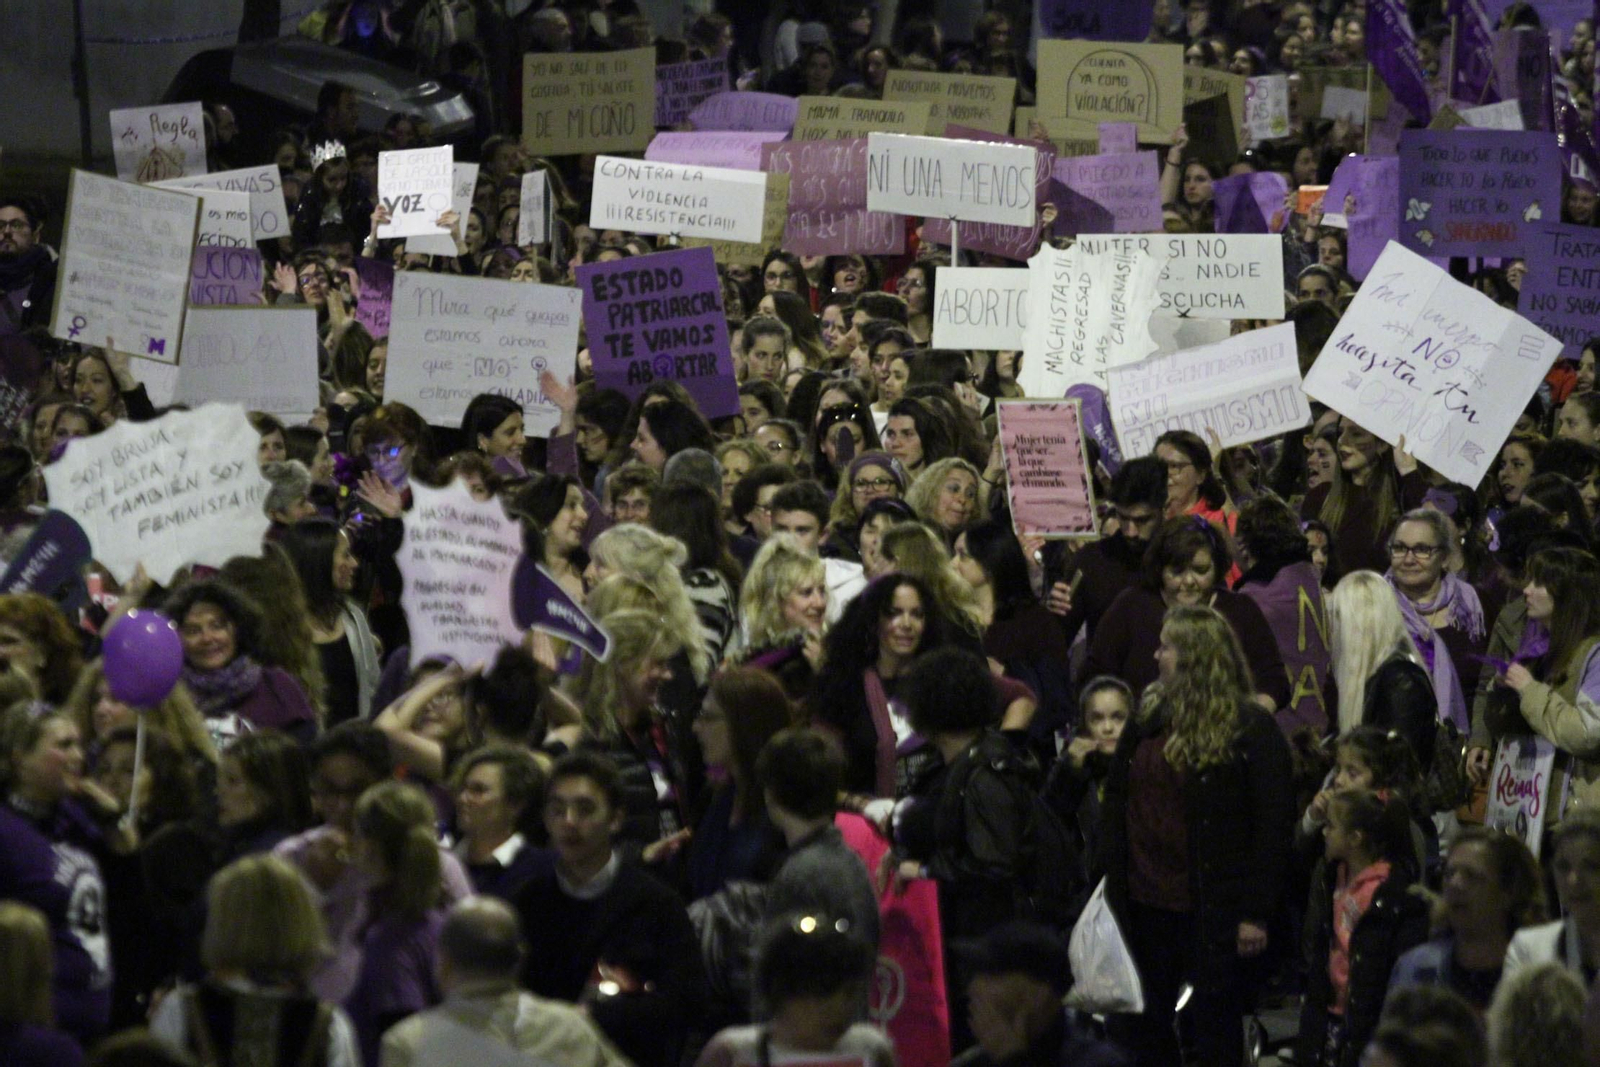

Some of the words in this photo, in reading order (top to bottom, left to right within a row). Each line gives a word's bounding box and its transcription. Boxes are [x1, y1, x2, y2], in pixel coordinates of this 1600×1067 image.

[1077, 72, 1093, 86] YA
[1097, 73, 1129, 88] COMO
[536, 111, 552, 139] DE
[589, 100, 636, 139] COÑO
[599, 160, 674, 182] CONTRA
[681, 169, 704, 182] LA
[868, 148, 890, 195] NI
[902, 155, 944, 200] UNA
[959, 161, 1032, 210] MENOS
[382, 192, 426, 216] VOZ
[627, 187, 709, 208] VIOLENCIA
[1168, 238, 1187, 259] SI
[1196, 237, 1227, 258] NO
[590, 266, 684, 303] ESTADO
[1196, 261, 1262, 281] NADIE
[1556, 265, 1600, 289] ENT
[413, 286, 472, 318] Mira
[607, 290, 723, 330] PATRIARCAL
[1530, 293, 1558, 313] NO
[1069, 271, 1092, 366] REGRESAD
[423, 327, 482, 344] estamos
[498, 333, 548, 349] ahora
[603, 332, 636, 358] TE
[641, 323, 716, 353] VAMOS
[1094, 334, 1109, 365] LAS
[1411, 336, 1462, 376] NO
[417, 385, 475, 400] estamos
[1432, 381, 1480, 425] tu
[1015, 434, 1042, 448] Mujer
[69, 460, 105, 488] SOY
[110, 429, 170, 469] BRUJA
[113, 463, 164, 496] LISTA
[176, 449, 188, 470] Y
[209, 459, 246, 486] SOY
